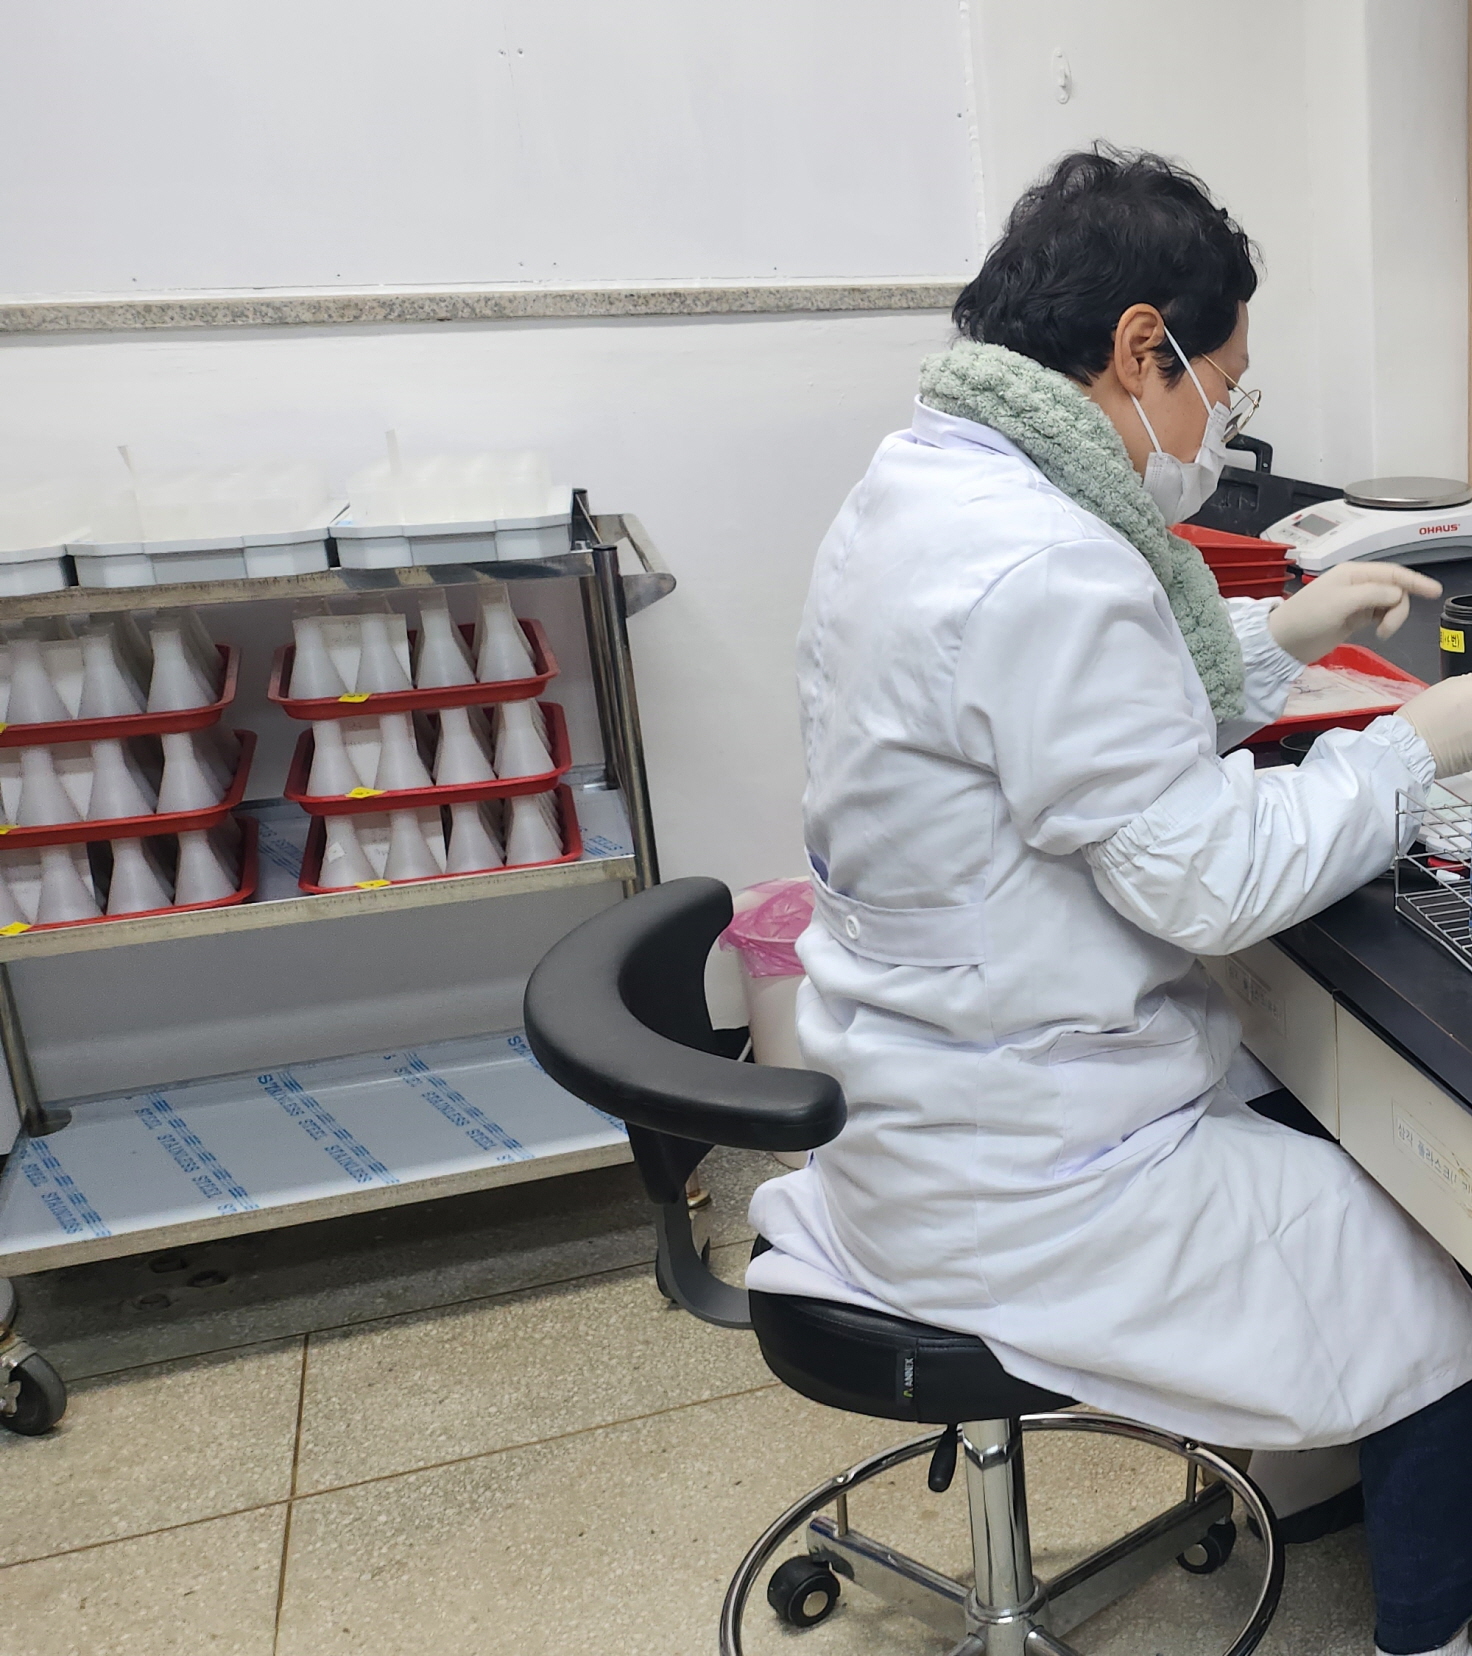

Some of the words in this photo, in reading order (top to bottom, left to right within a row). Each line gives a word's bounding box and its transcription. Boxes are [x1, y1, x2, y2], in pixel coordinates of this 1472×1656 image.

[1418, 523, 1458, 535] OHAUS
[421, 1090, 471, 1127] STAINLESS
[465, 1128, 497, 1151] STEEL
[1398, 1123, 1414, 1147] 삼각
[134, 1107, 162, 1130] STEEL
[157, 1133, 200, 1173] STAINLESS
[192, 1175, 222, 1199] STEEL
[299, 1118, 328, 1141] STEEL
[324, 1144, 373, 1184] STAINLESS
[41, 1191, 84, 1235] STAINLESS
